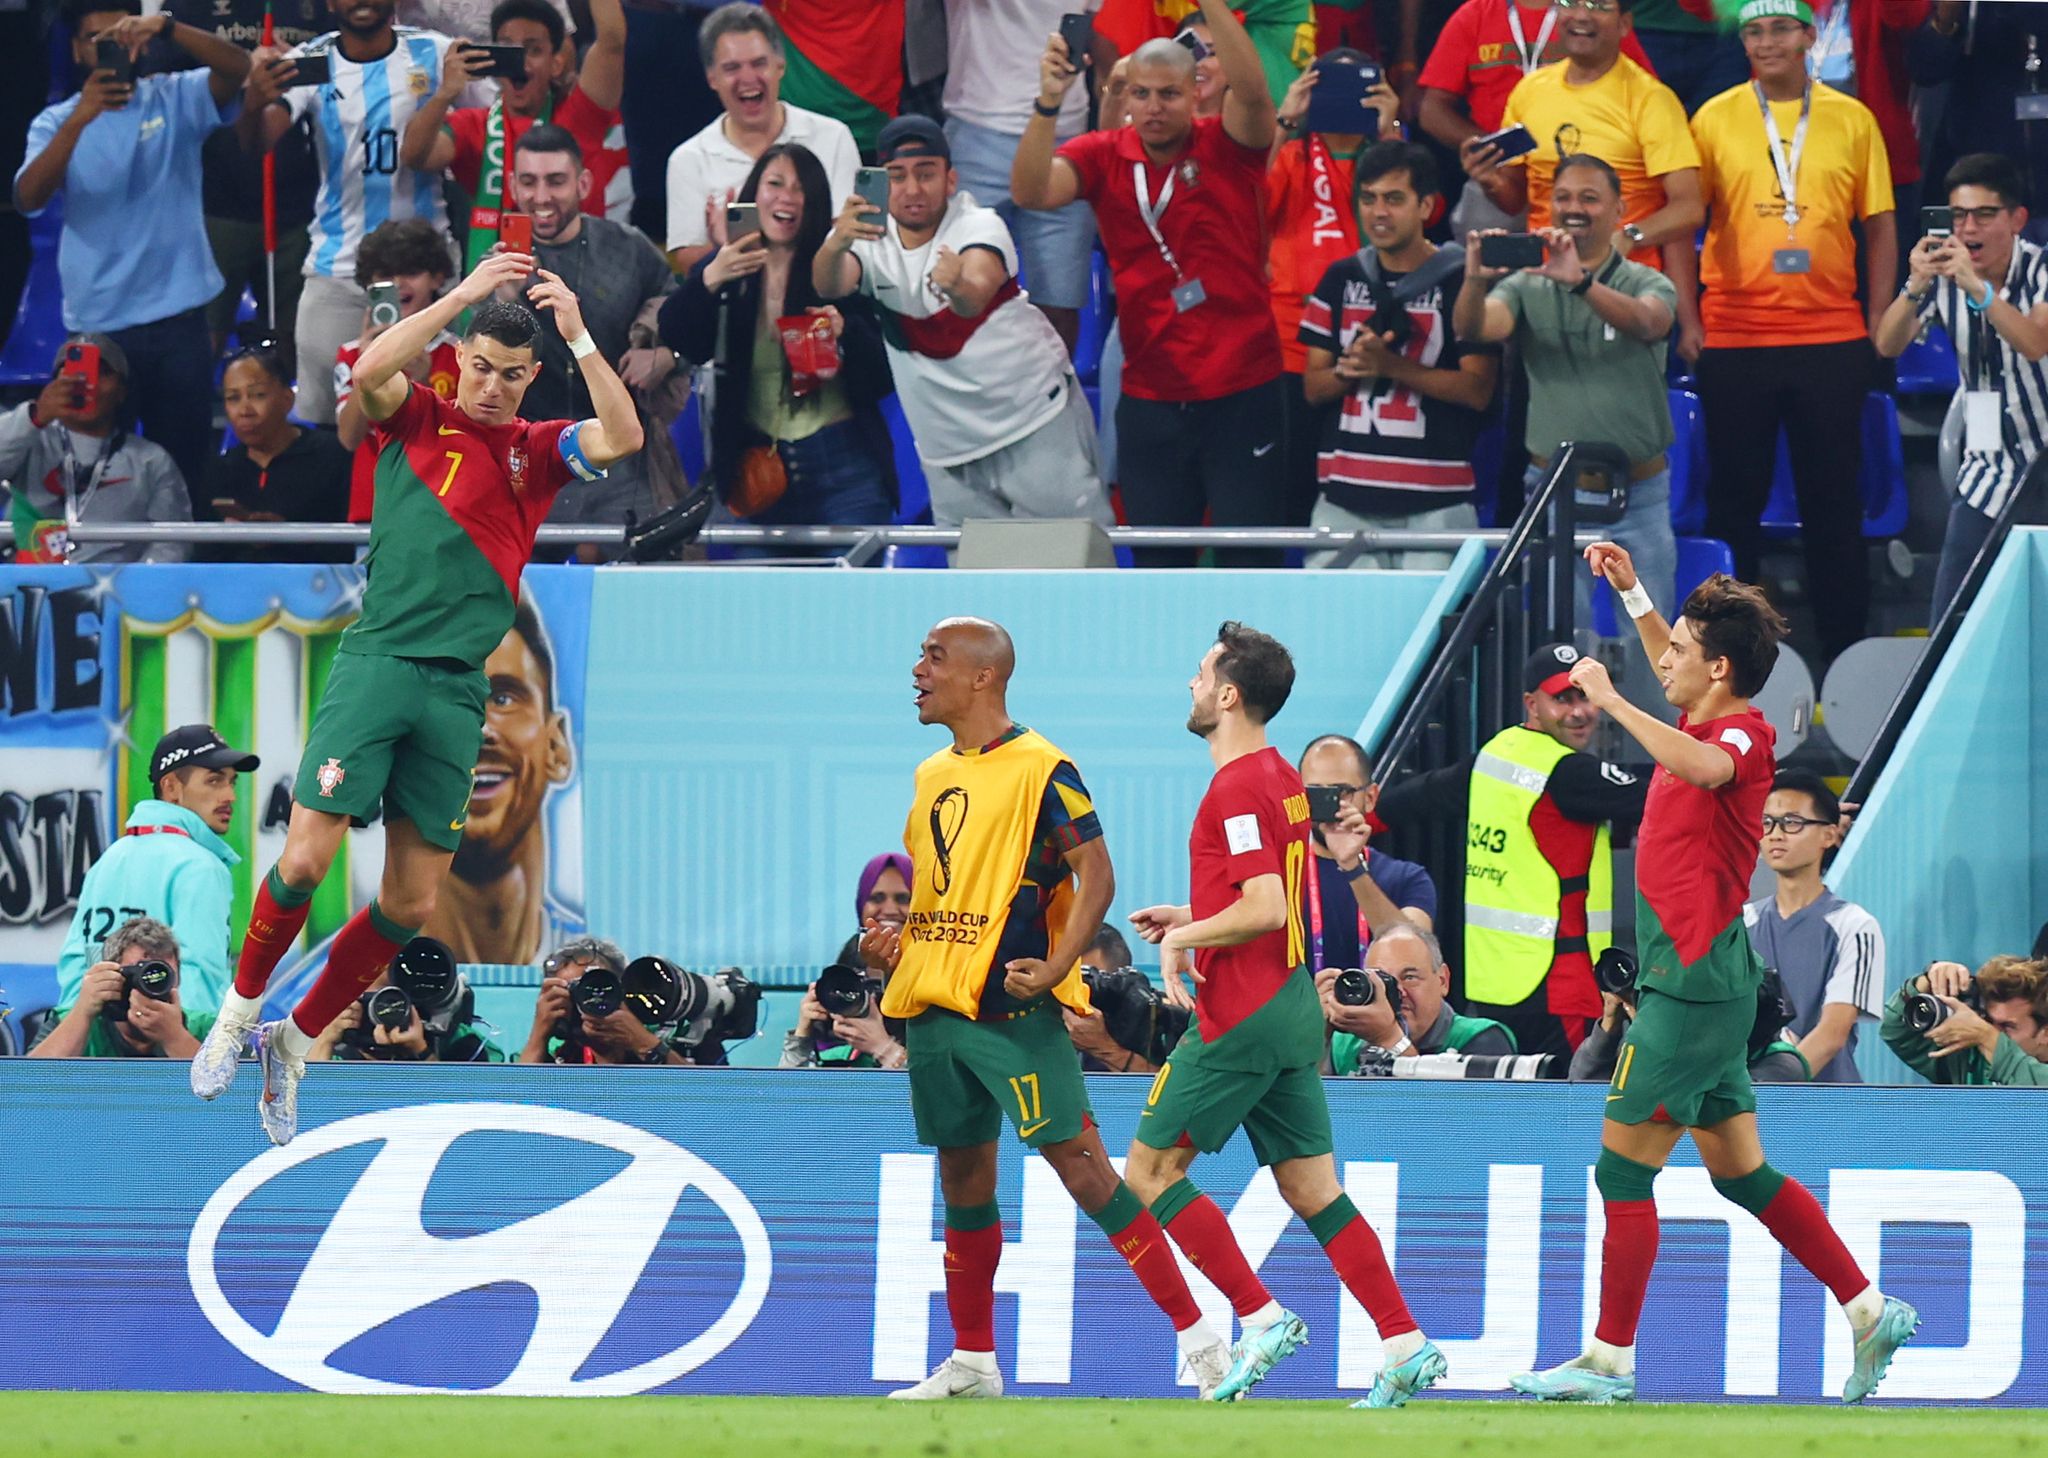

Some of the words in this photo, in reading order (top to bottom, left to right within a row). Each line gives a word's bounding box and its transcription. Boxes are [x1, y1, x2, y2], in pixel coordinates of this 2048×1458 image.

[361, 129, 398, 174] 10
[438, 451, 463, 497] 7
[1466, 862, 1508, 887] ecurity
[933, 926, 978, 945] 2022
[959, 911, 989, 928] CUP
[1008, 1072, 1042, 1122] 17
